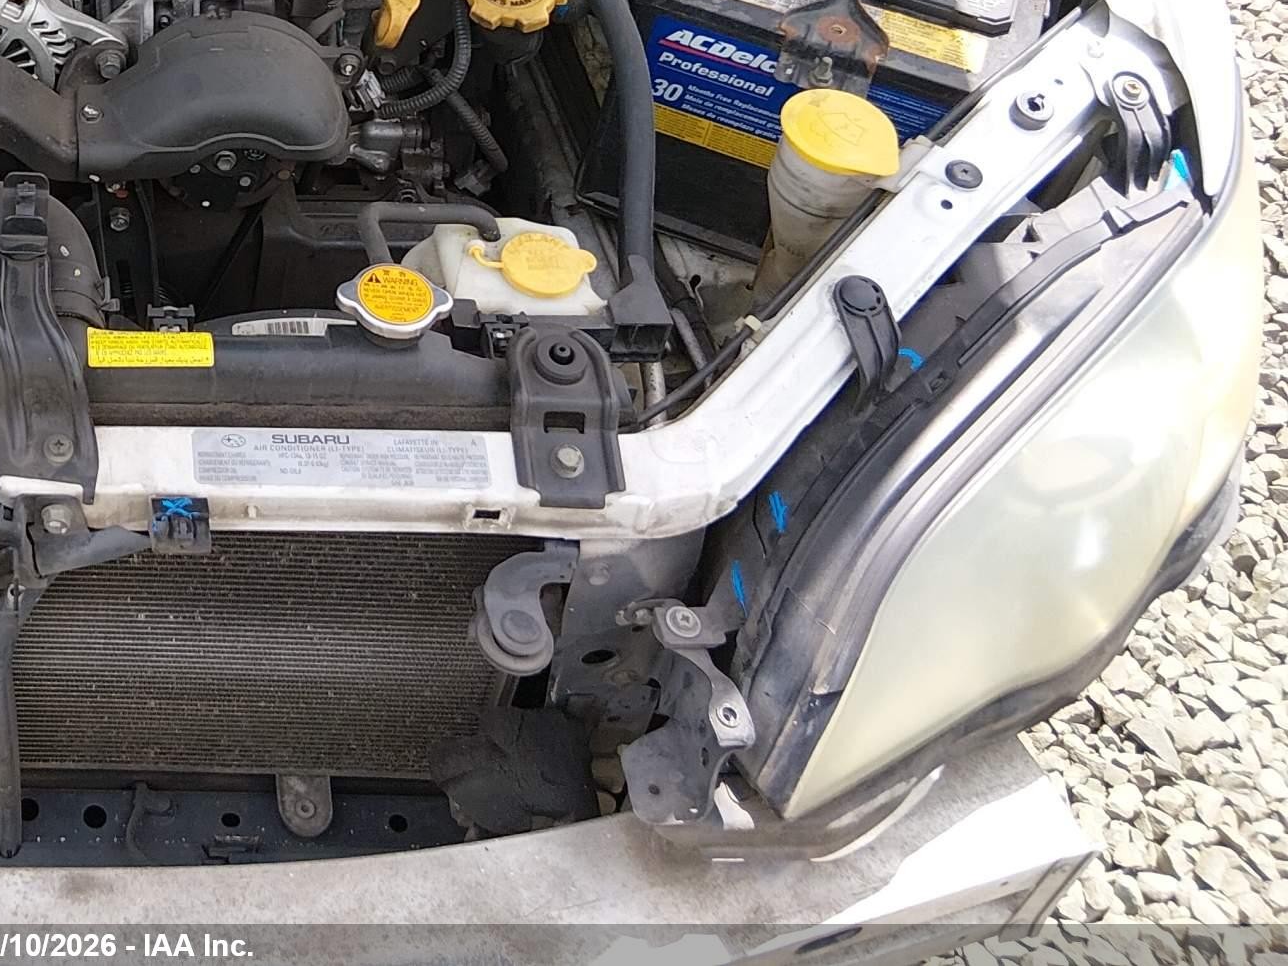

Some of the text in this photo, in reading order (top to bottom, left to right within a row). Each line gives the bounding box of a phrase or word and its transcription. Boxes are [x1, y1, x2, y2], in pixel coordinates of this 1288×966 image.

[665, 29, 778, 74] ACDelc
[659, 51, 774, 97] Professional
[652, 78, 683, 101] 30
[383, 277, 418, 286] WARNING
[270, 444, 326, 452] CONDITIONER
[271, 434, 350, 445] SUBARU
